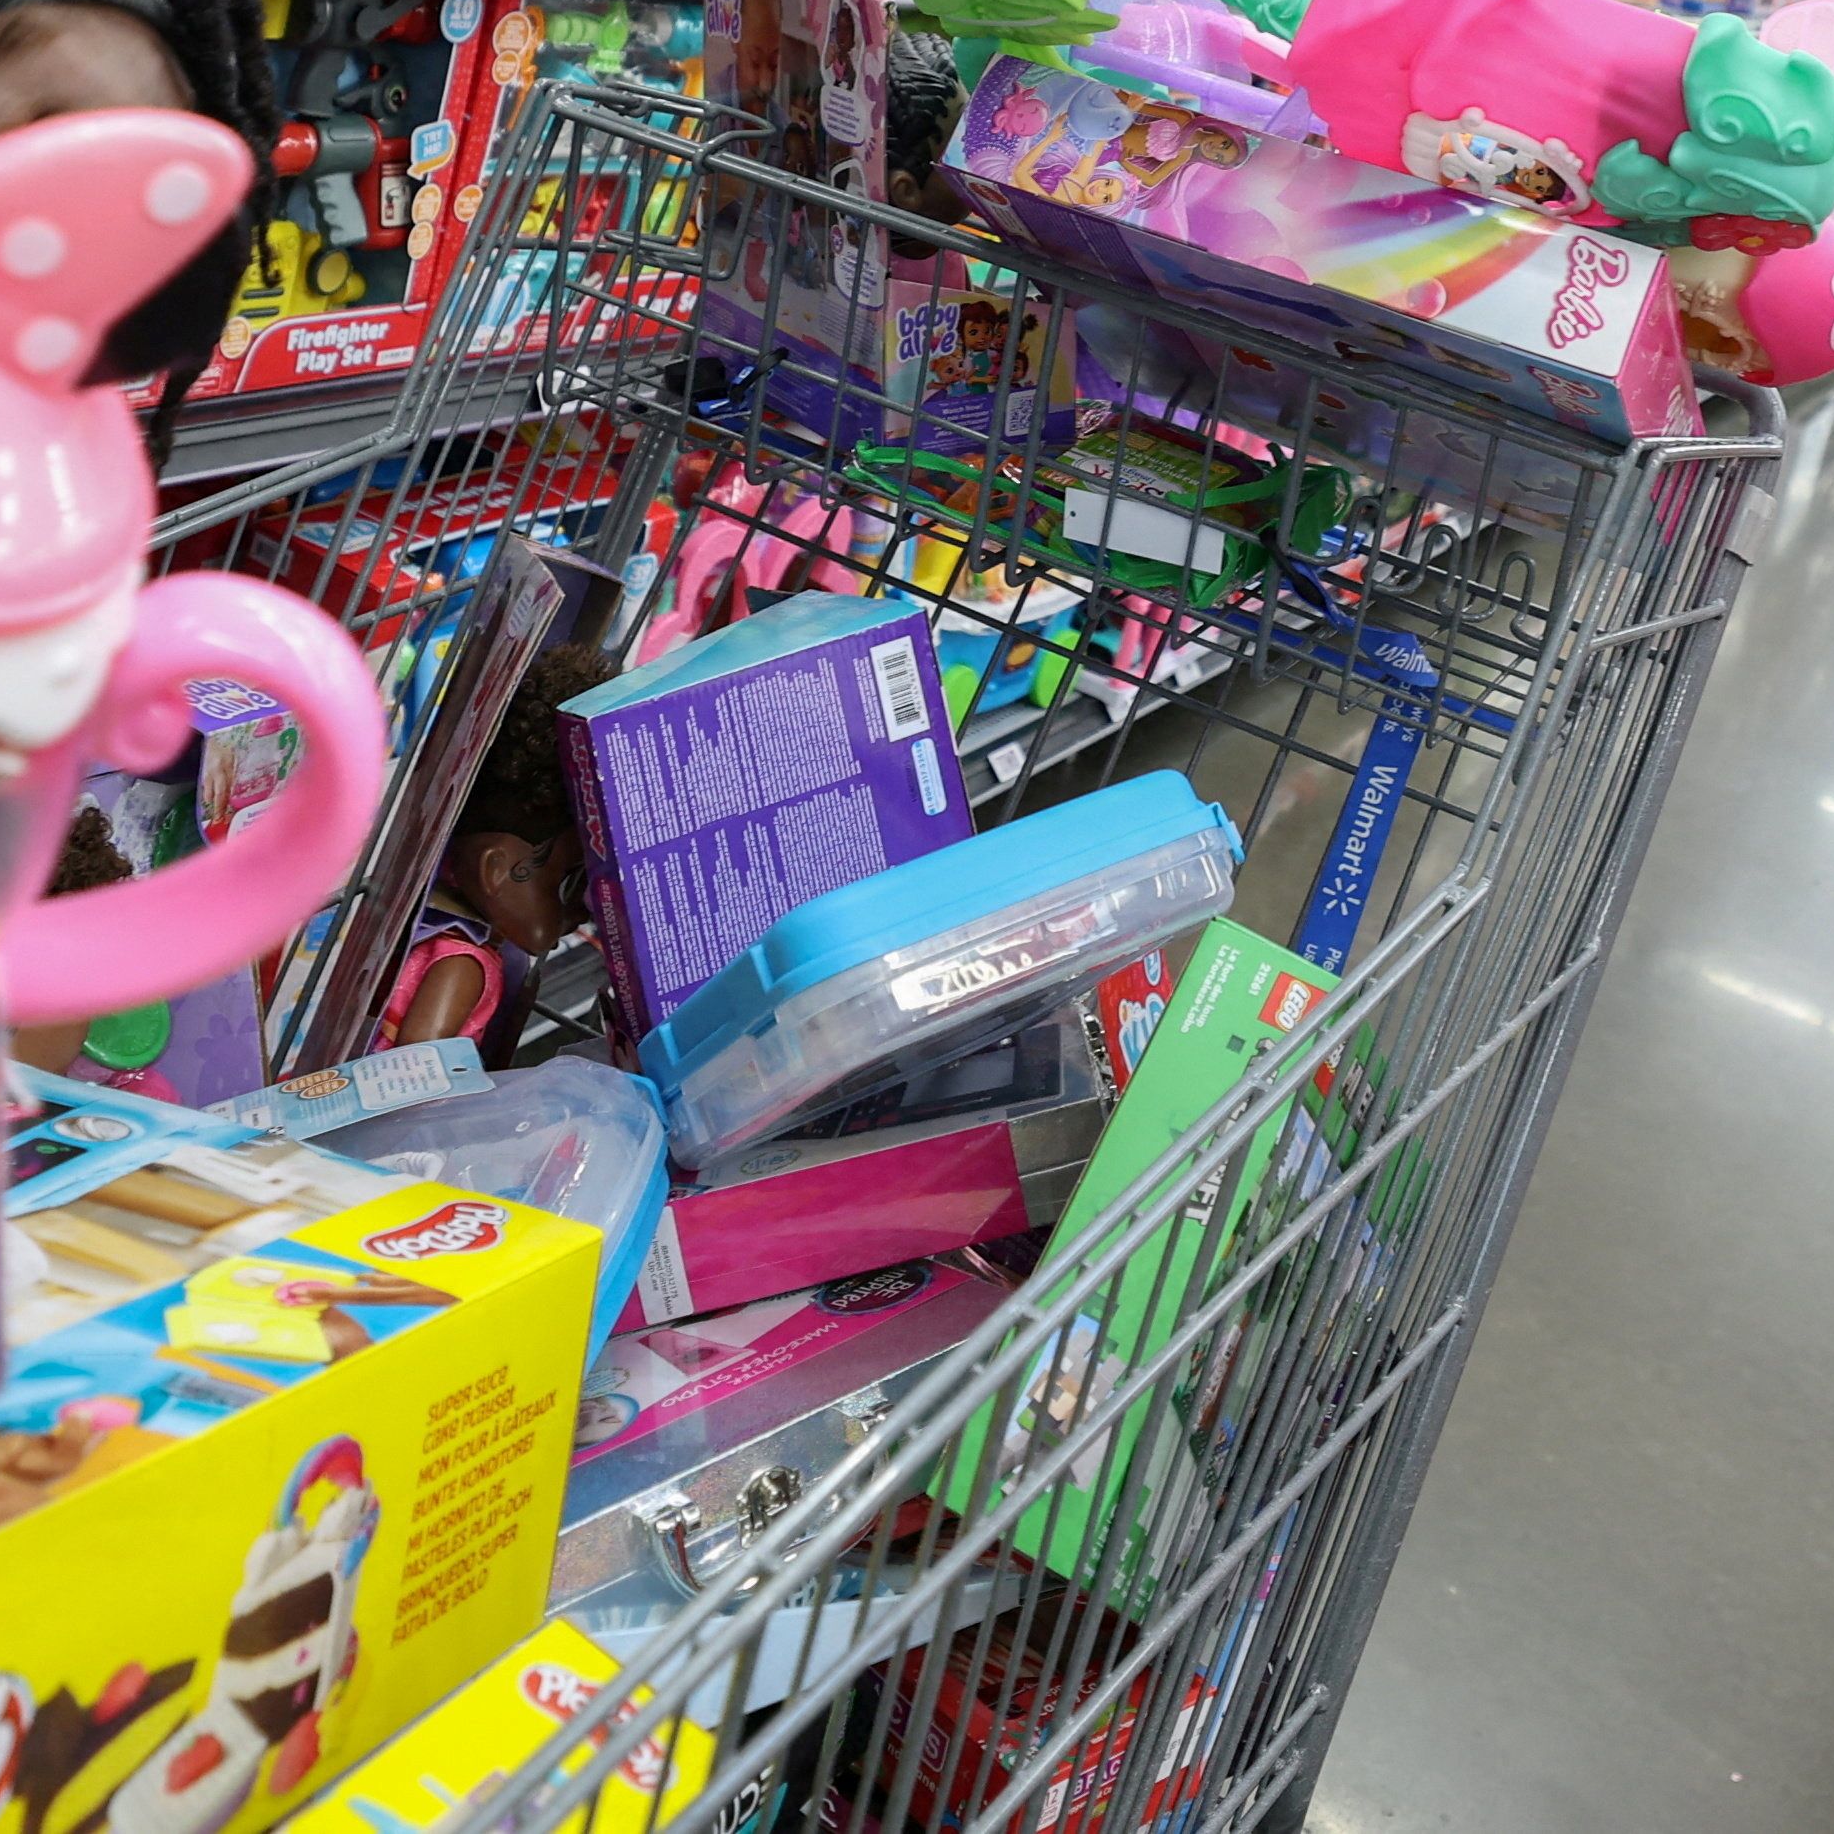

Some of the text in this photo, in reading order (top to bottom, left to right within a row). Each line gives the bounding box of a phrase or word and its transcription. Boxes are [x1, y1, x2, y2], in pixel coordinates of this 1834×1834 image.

[1549, 237, 1628, 349] Barbie
[286, 321, 390, 353] Firefighter
[295, 342, 373, 375] Play Set
[1338, 765, 1399, 877] Walmart
[1216, 944, 1231, 958] La
[1196, 948, 1241, 1028] Le fort des loup
[1249, 962, 1272, 997] 21261
[1275, 980, 1310, 1032] LEGO
[372, 1205, 506, 1261] Play-Doh
[651, 1241, 665, 1273] Inspired
[874, 1277, 915, 1301] BE
[660, 1322, 839, 1409] MAKEOVER STUDIO
[727, 1352, 795, 1387] GLITTER
[418, 1452, 451, 1488] MON
[452, 1429, 490, 1466] FOUR
[500, 1388, 559, 1439] GÂTEAUX
[411, 1477, 459, 1523] BUNTE
[424, 1493, 487, 1539] HORNITO
[485, 1478, 506, 1508] DE
[402, 1484, 534, 1583] PASTELES PLAY-DOH
[396, 1522, 519, 1621] BRINQUEDO SUPER
[390, 1566, 489, 1648] FATIA DE BOLO
